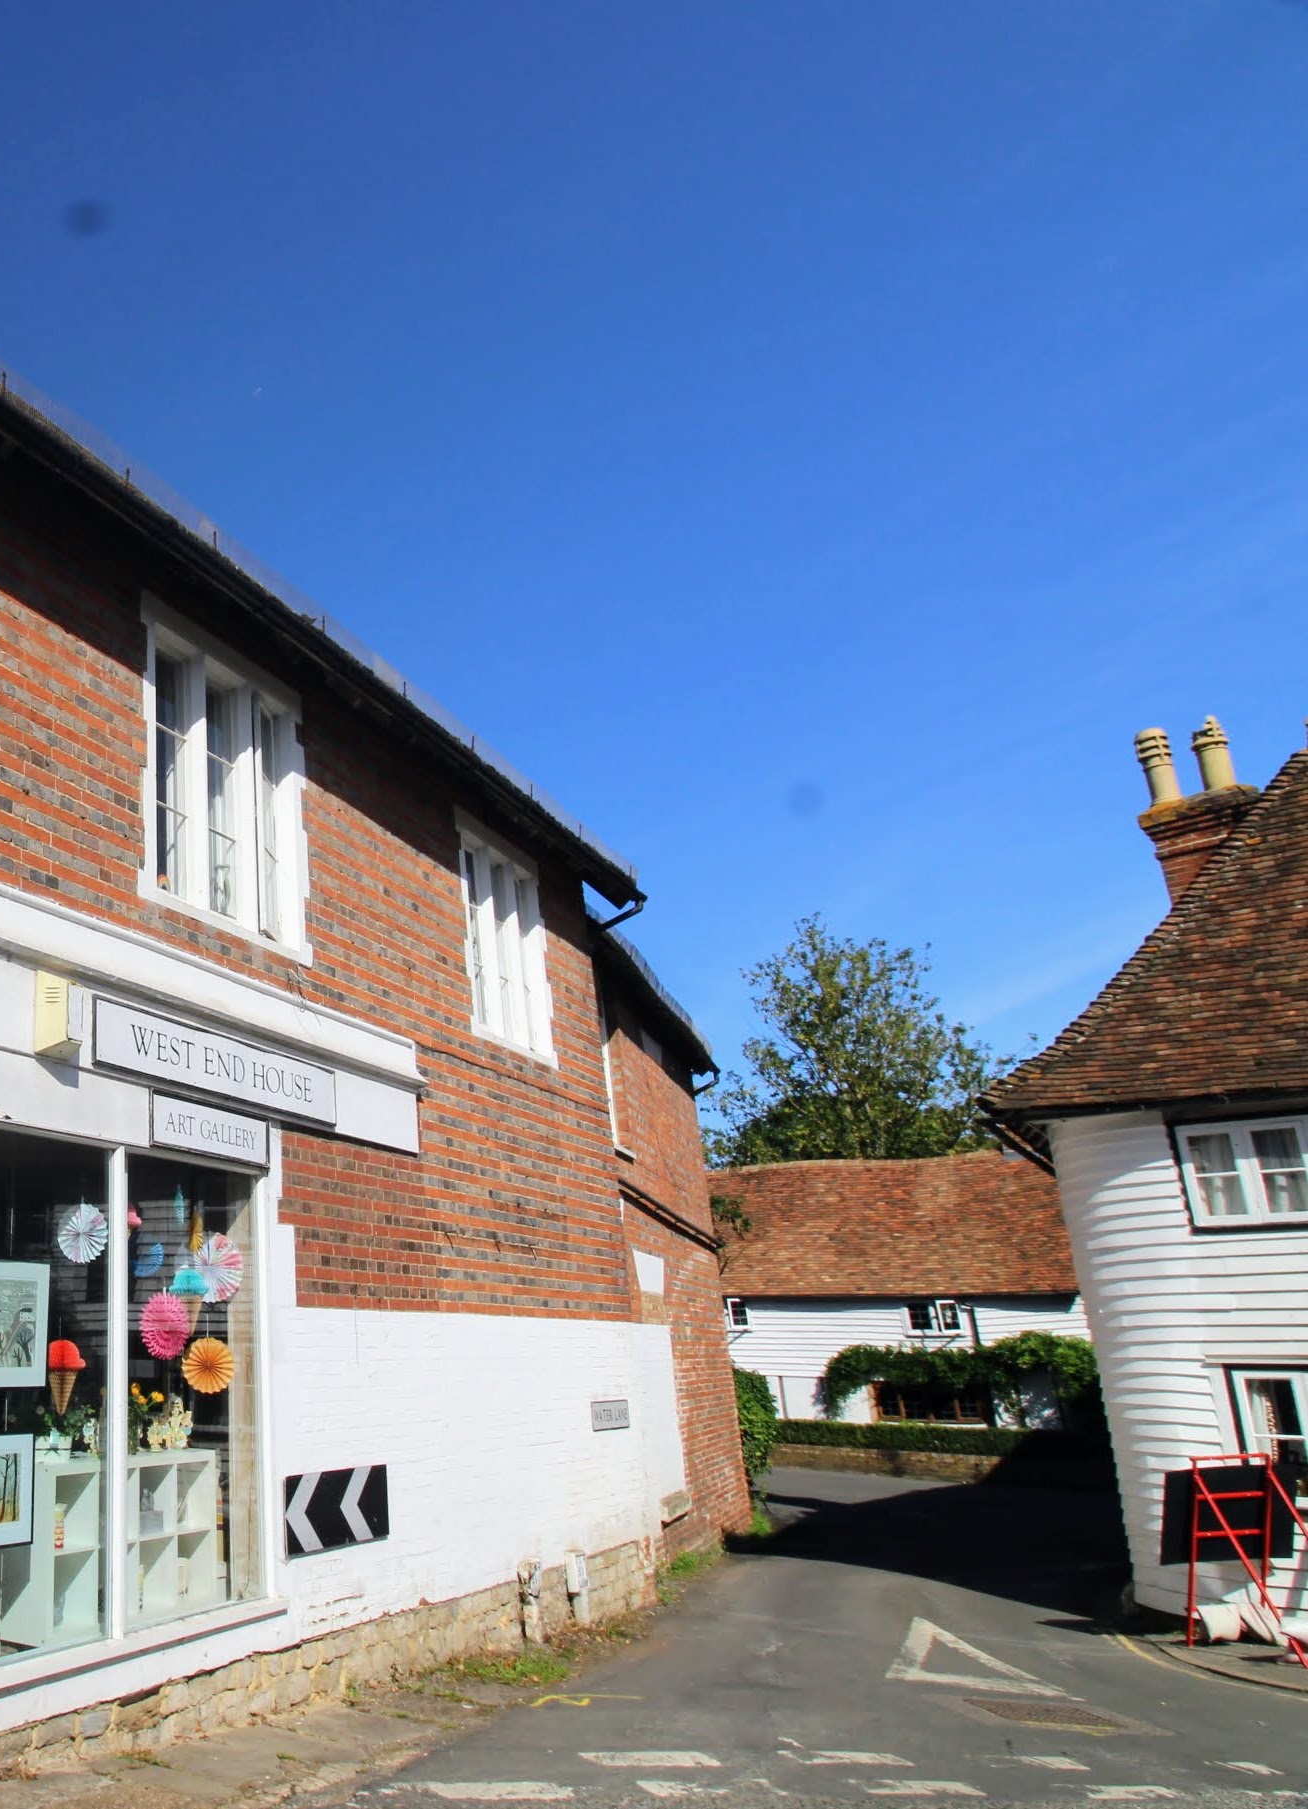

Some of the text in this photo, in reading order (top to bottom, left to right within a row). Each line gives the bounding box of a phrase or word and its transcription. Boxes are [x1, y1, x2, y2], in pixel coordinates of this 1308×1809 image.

[130, 1023, 313, 1103] WEST END HOUSE
[164, 1111, 258, 1150] ART GALLERY
[594, 1408, 614, 1422] WATER
